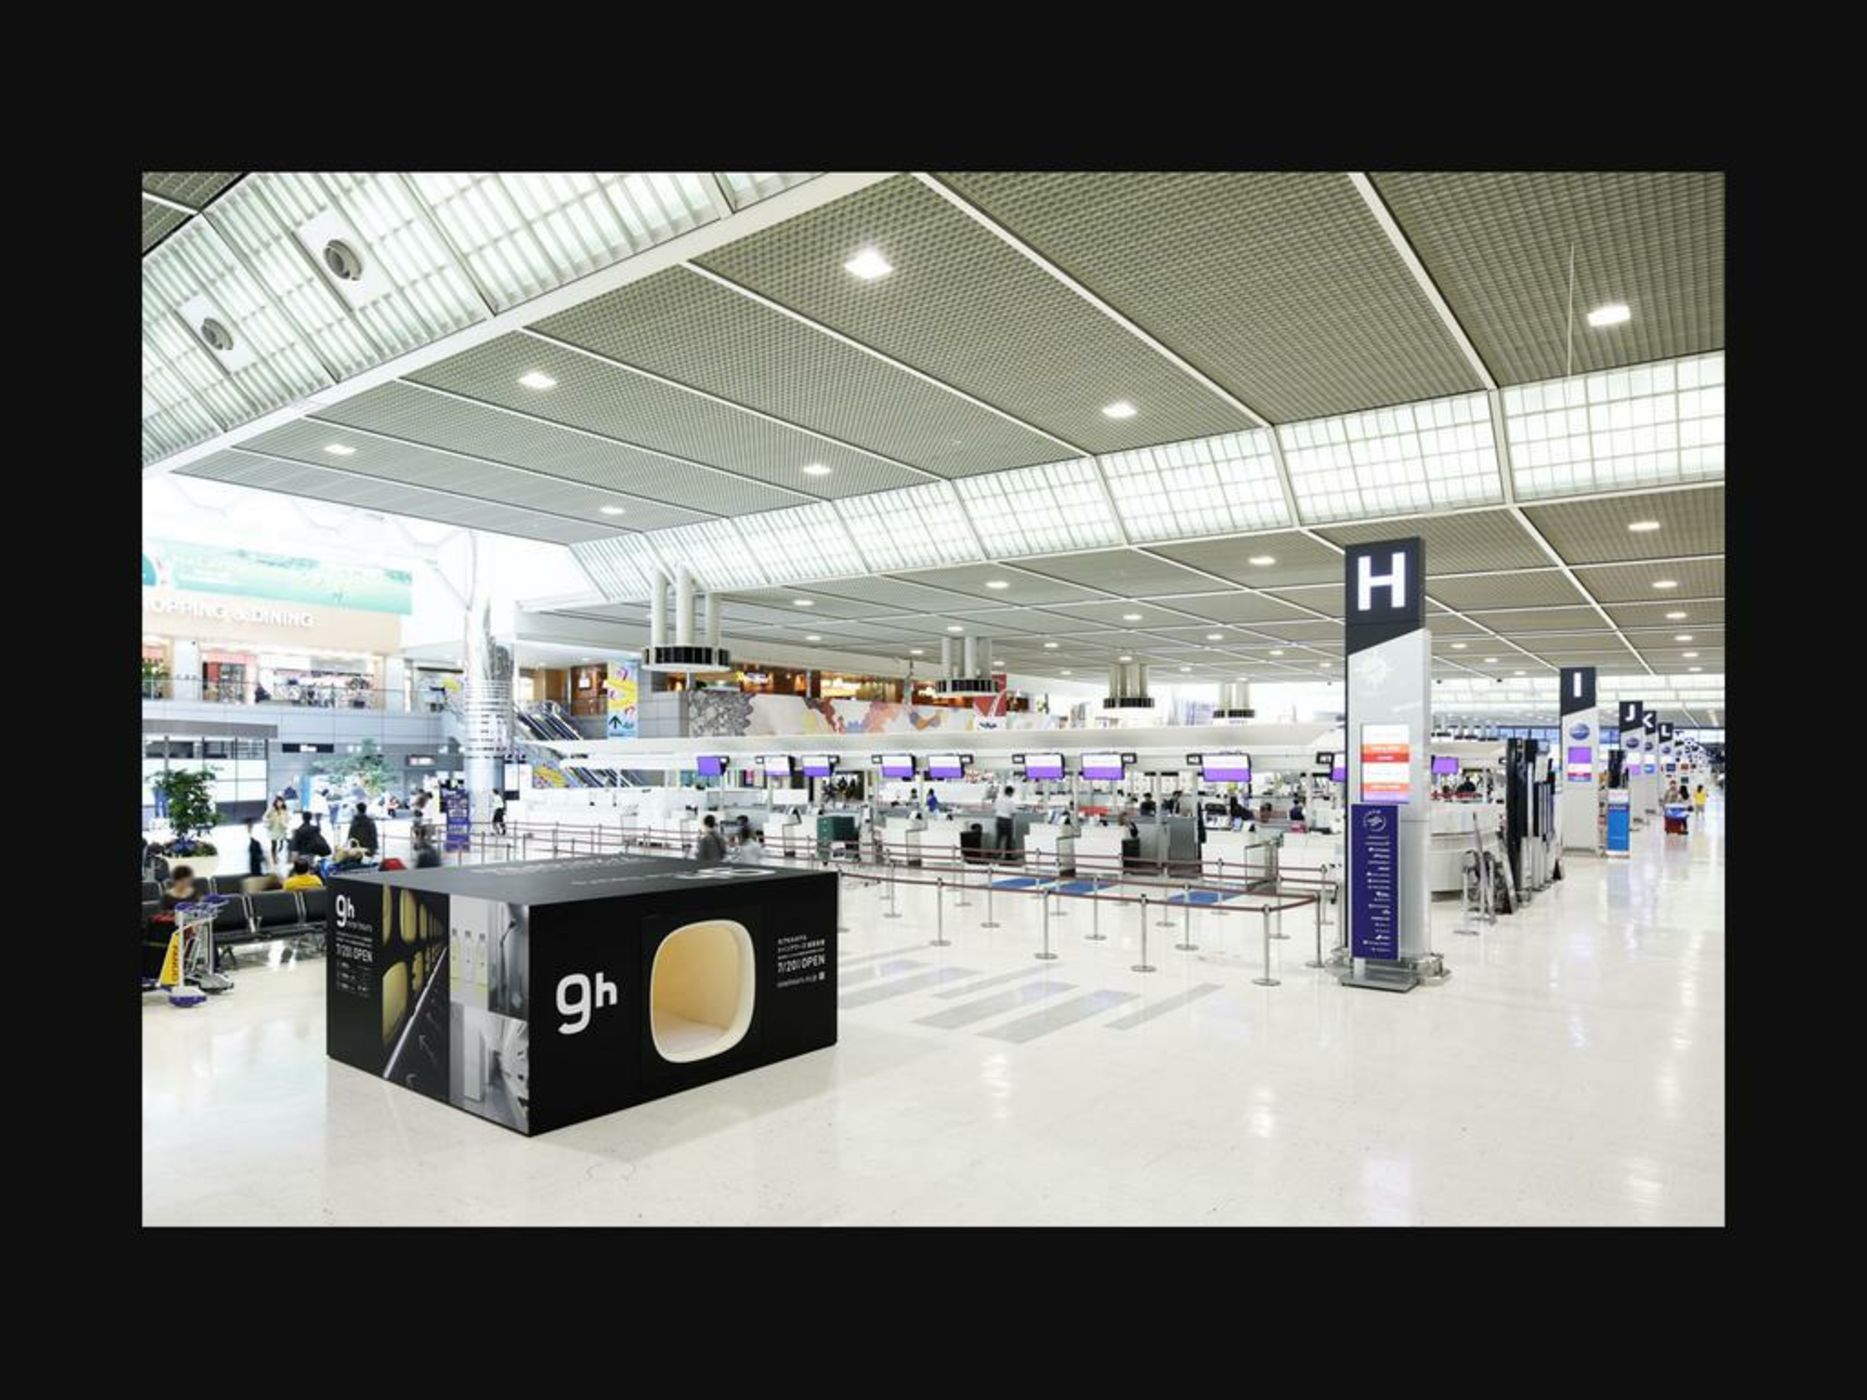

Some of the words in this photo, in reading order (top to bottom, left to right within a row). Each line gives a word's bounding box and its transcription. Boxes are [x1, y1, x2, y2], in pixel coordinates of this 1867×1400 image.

[1358, 552, 1405, 611] H
[232, 609, 247, 622] &
[251, 608, 314, 628] DINING
[1625, 704, 1636, 721] J
[1661, 724, 1670, 737] L
[335, 894, 355, 928] 9h
[802, 954, 825, 969] OPEN
[556, 972, 618, 1034] 9h
